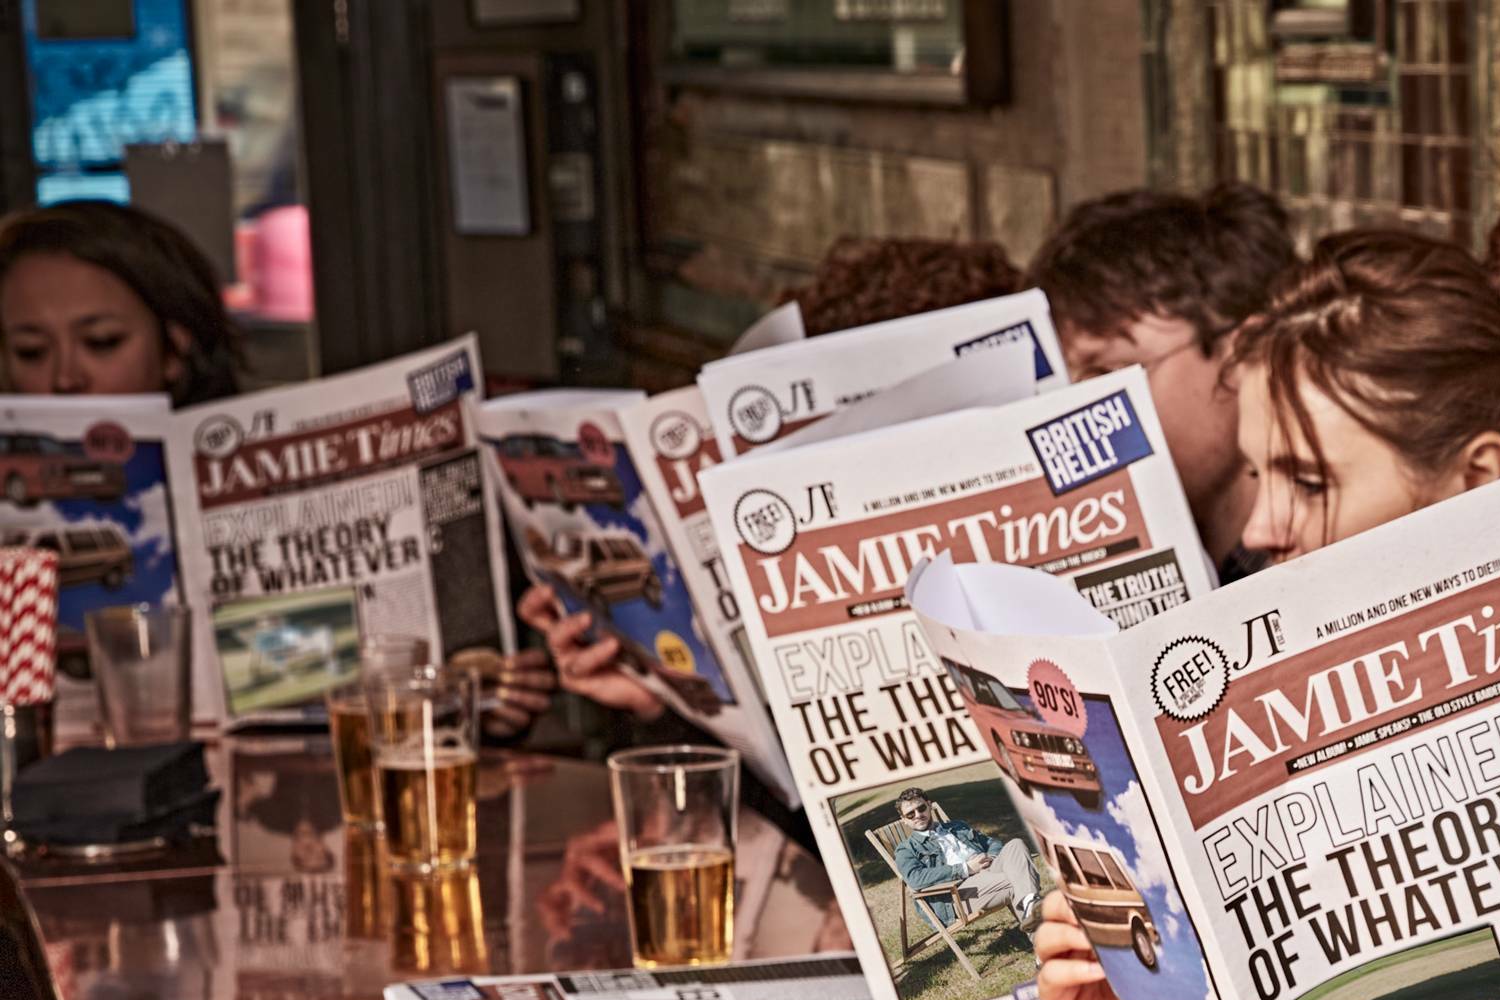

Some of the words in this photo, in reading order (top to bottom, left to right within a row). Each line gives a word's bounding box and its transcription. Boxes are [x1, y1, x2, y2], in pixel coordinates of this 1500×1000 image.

[201, 433, 346, 495] JAMIE
[346, 409, 457, 464] Times
[1032, 396, 1132, 460] BRITISH
[1045, 435, 1119, 488] HELL!
[799, 482, 837, 525] JT
[208, 535, 267, 575] THE
[277, 514, 391, 561] THEORY
[209, 573, 245, 595] OF
[258, 536, 421, 592] WHATEVER
[754, 525, 943, 614] JAMIE
[949, 489, 1127, 566] Times
[1080, 580, 1118, 607] THE
[1115, 562, 1181, 601] TRUTH!
[1316, 627, 1324, 639] A
[1325, 612, 1365, 636] MILLION
[1366, 600, 1388, 621] AND
[1388, 594, 1409, 613] ONE
[1410, 586, 1433, 608] NEW
[1434, 575, 1462, 599] WAYS
[1461, 570, 1477, 588] TO
[1233, 609, 1286, 671] JT
[1163, 650, 1215, 700] FREE!
[791, 691, 877, 744] THE
[1178, 647, 1423, 795] JAMIE
[1418, 711, 1435, 724] THE
[1434, 704, 1451, 718] OLD
[1450, 692, 1477, 712] STYLE
[808, 740, 860, 785] OF
[869, 714, 978, 772] WHA
[1224, 862, 1322, 950] THE
